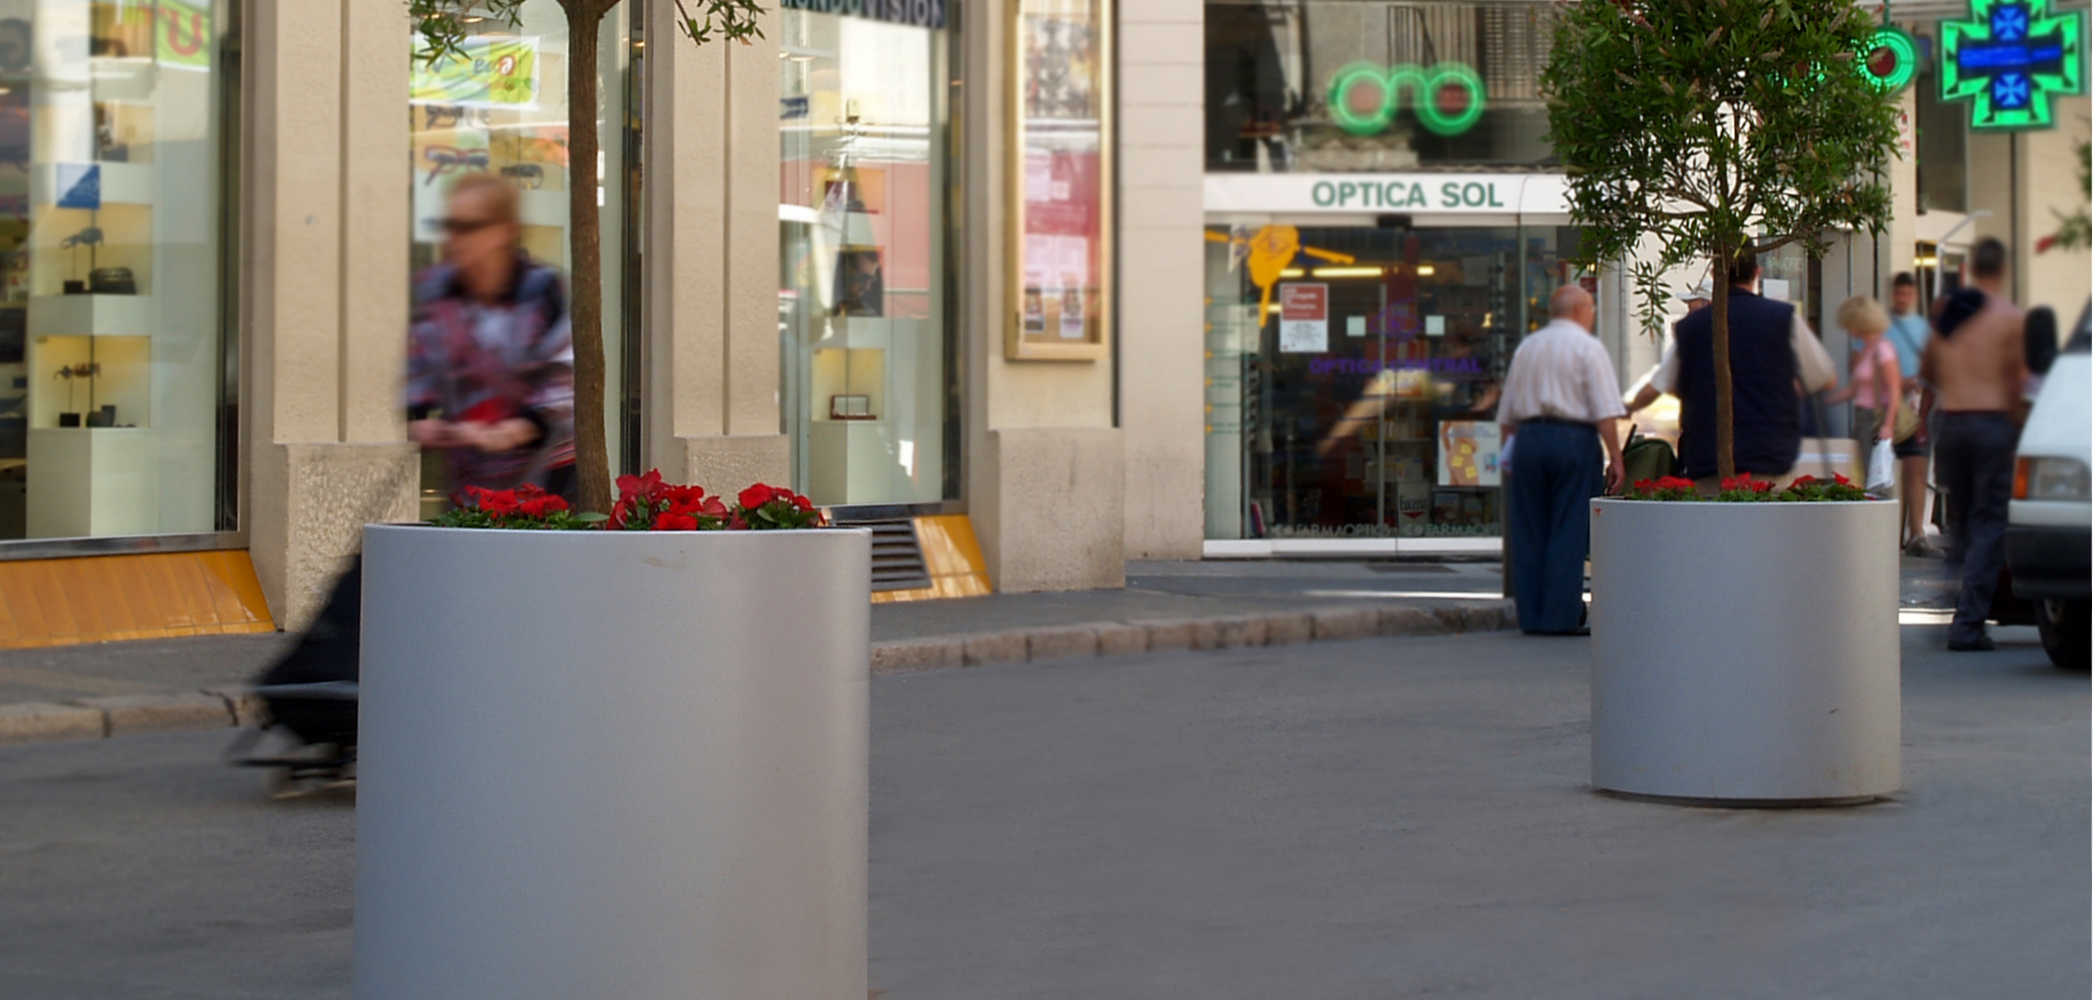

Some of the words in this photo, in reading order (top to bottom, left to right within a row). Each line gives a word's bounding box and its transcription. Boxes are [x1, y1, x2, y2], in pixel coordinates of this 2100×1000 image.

[780, 0, 943, 28] OVISION
[1312, 180, 1428, 208] OPTICA
[1441, 181, 1504, 208] SOL
